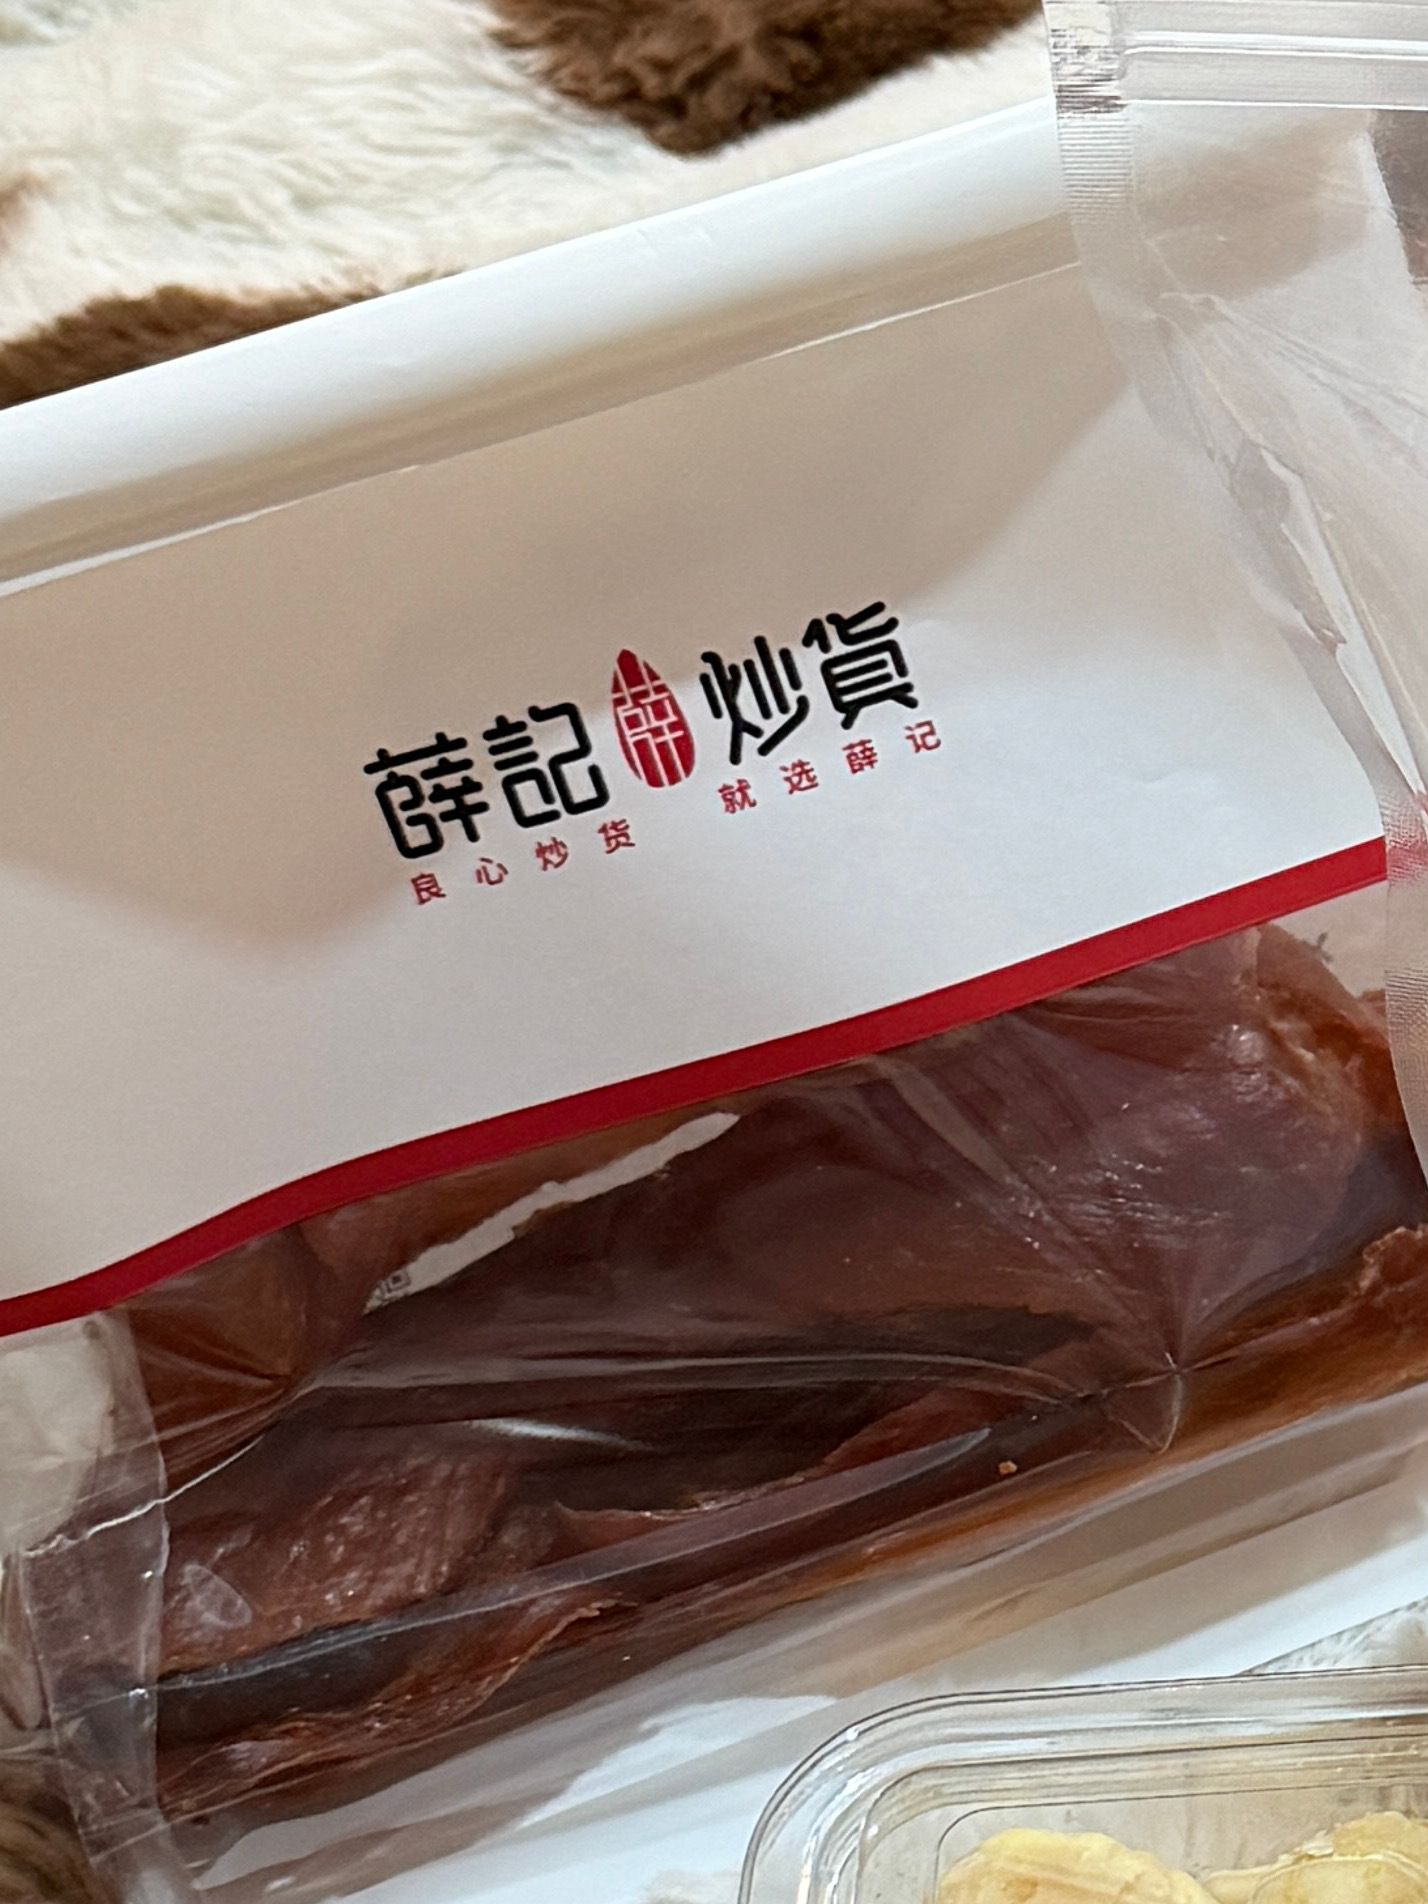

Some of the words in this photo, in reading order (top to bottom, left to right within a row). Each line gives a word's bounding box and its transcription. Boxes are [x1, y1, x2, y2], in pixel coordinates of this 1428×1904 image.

[410, 818, 637, 907] 良心炒货
[716, 719, 943, 816] 就选薛记
